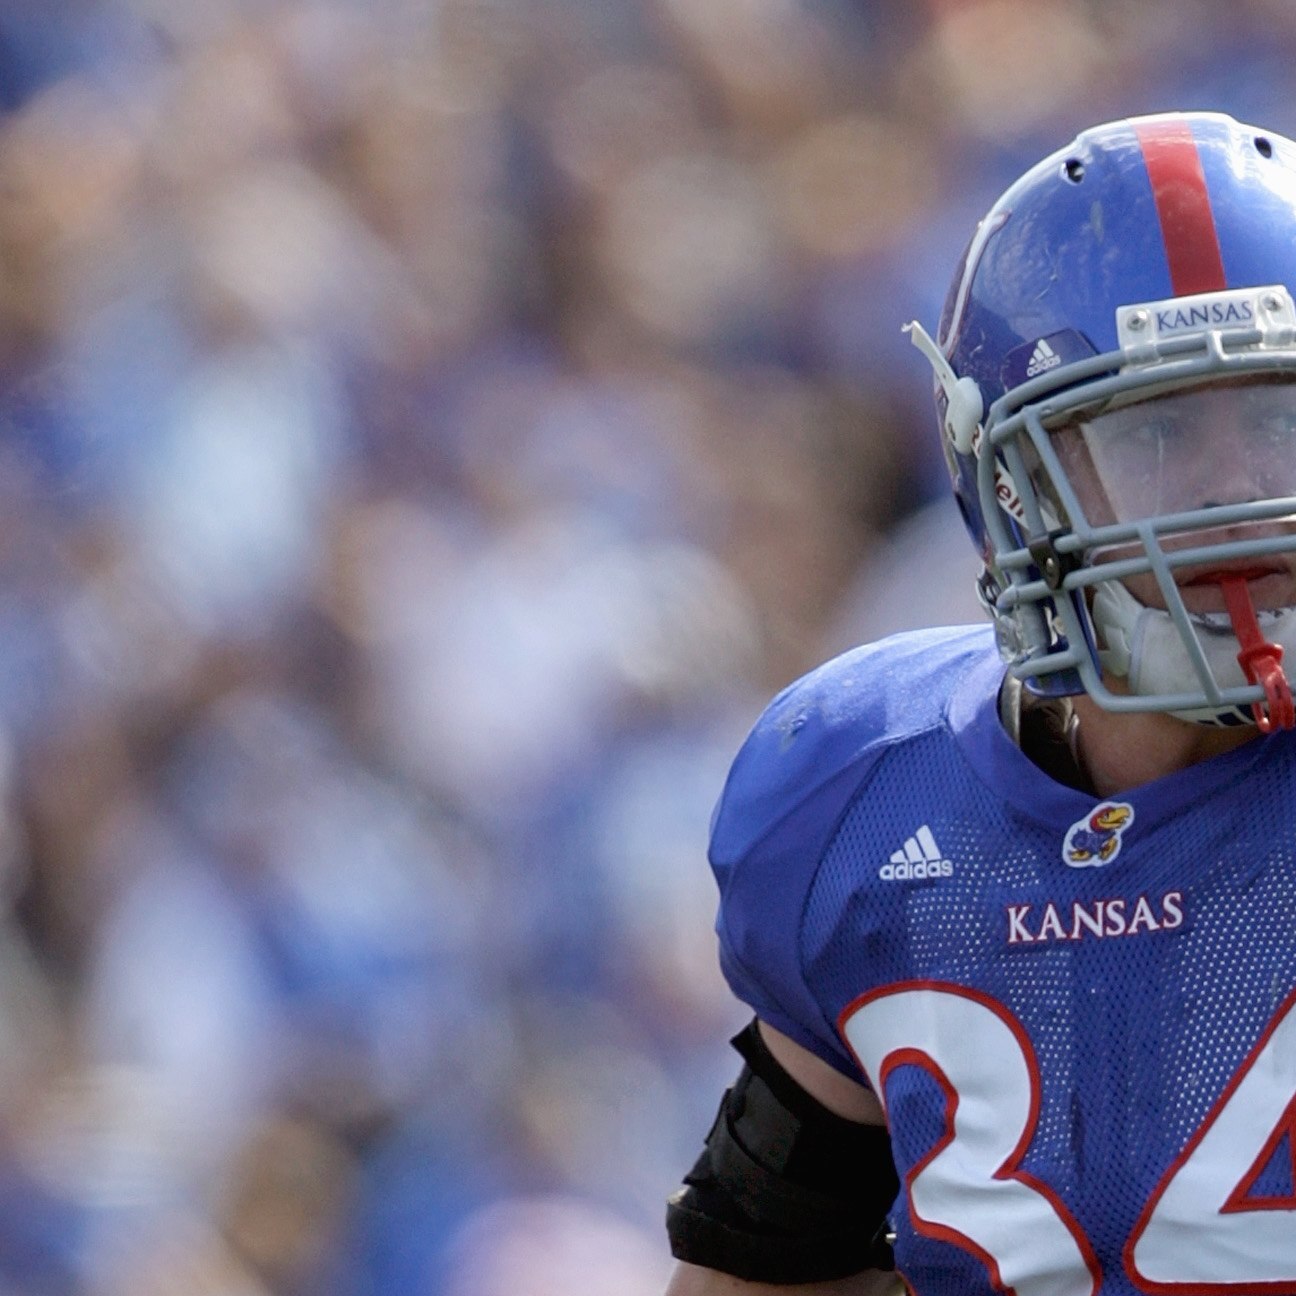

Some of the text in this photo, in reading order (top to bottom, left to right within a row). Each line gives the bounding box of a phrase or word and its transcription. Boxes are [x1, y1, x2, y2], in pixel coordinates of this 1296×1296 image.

[1156, 301, 1254, 331] KANSAS
[879, 858, 954, 880] adidas
[1006, 890, 1185, 945] KANSAS
